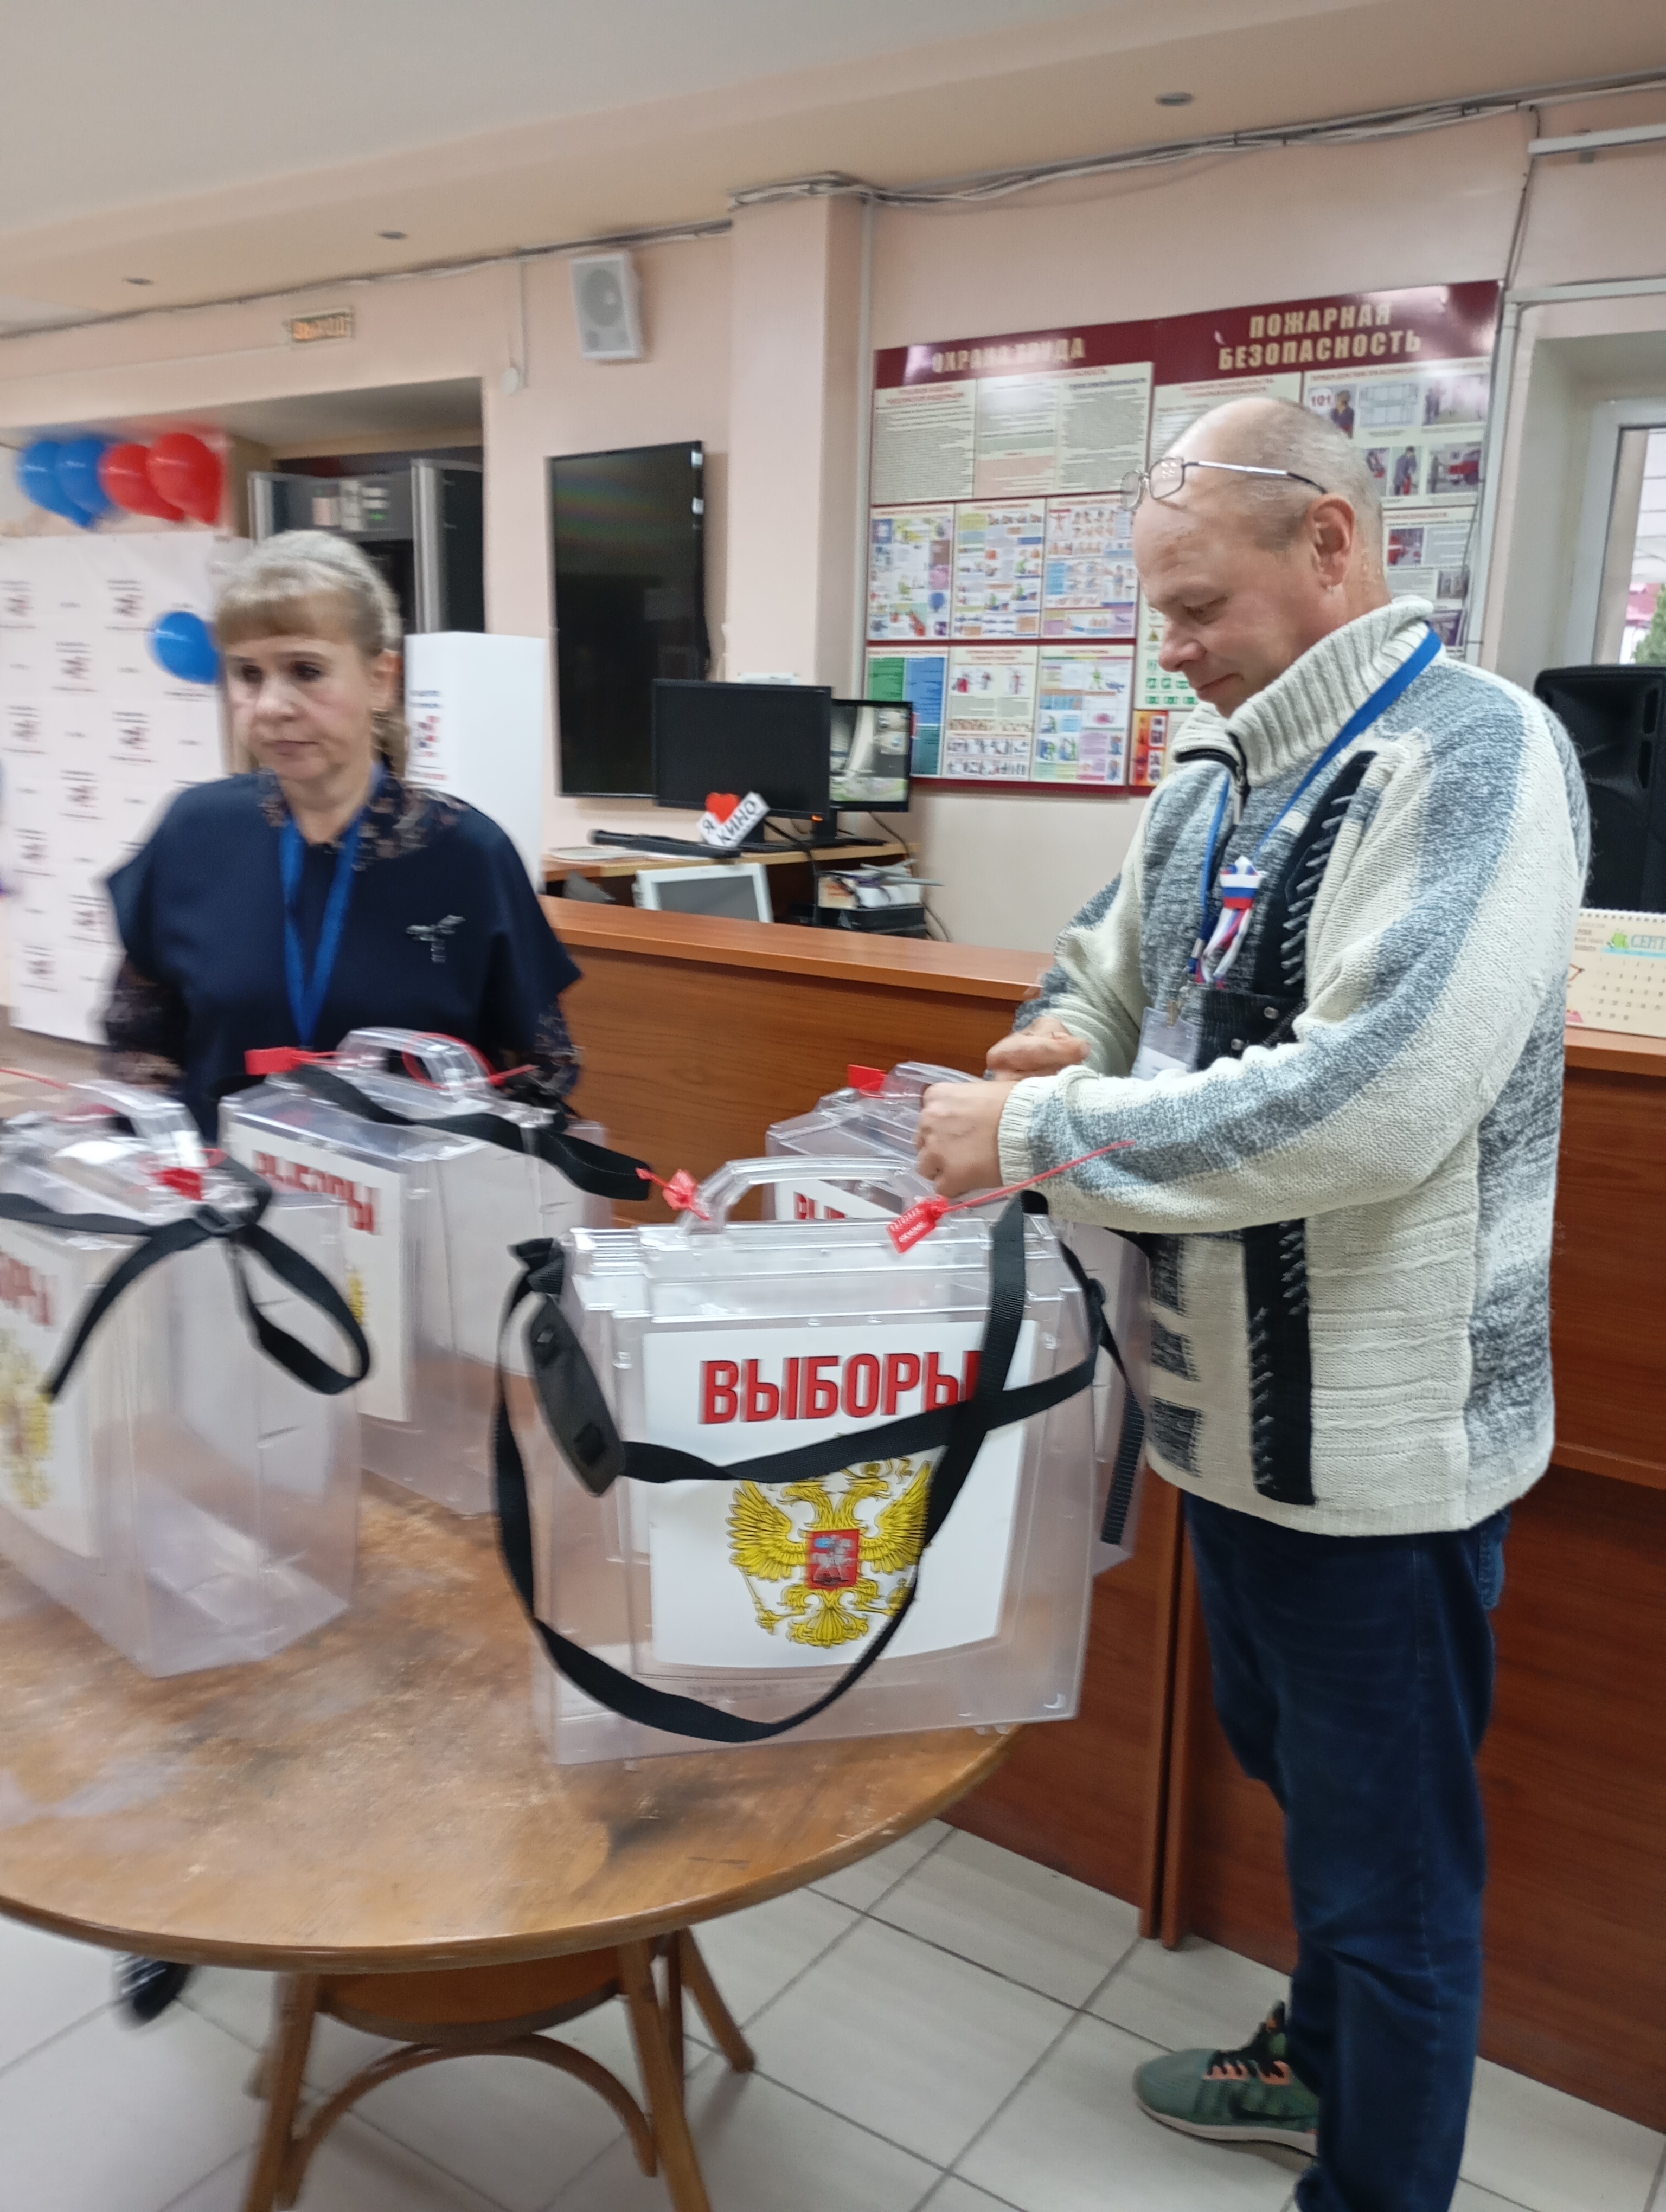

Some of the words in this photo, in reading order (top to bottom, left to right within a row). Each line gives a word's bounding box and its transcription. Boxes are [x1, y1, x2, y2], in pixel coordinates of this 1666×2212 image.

[1250, 303, 1391, 338] ПОЖАРНАЯ
[1218, 329, 1422, 370] БЕЗОПАСНОСТЬ
[716, 800, 757, 845] КИНО
[699, 1351, 983, 1425] ВЫБОРЫ
